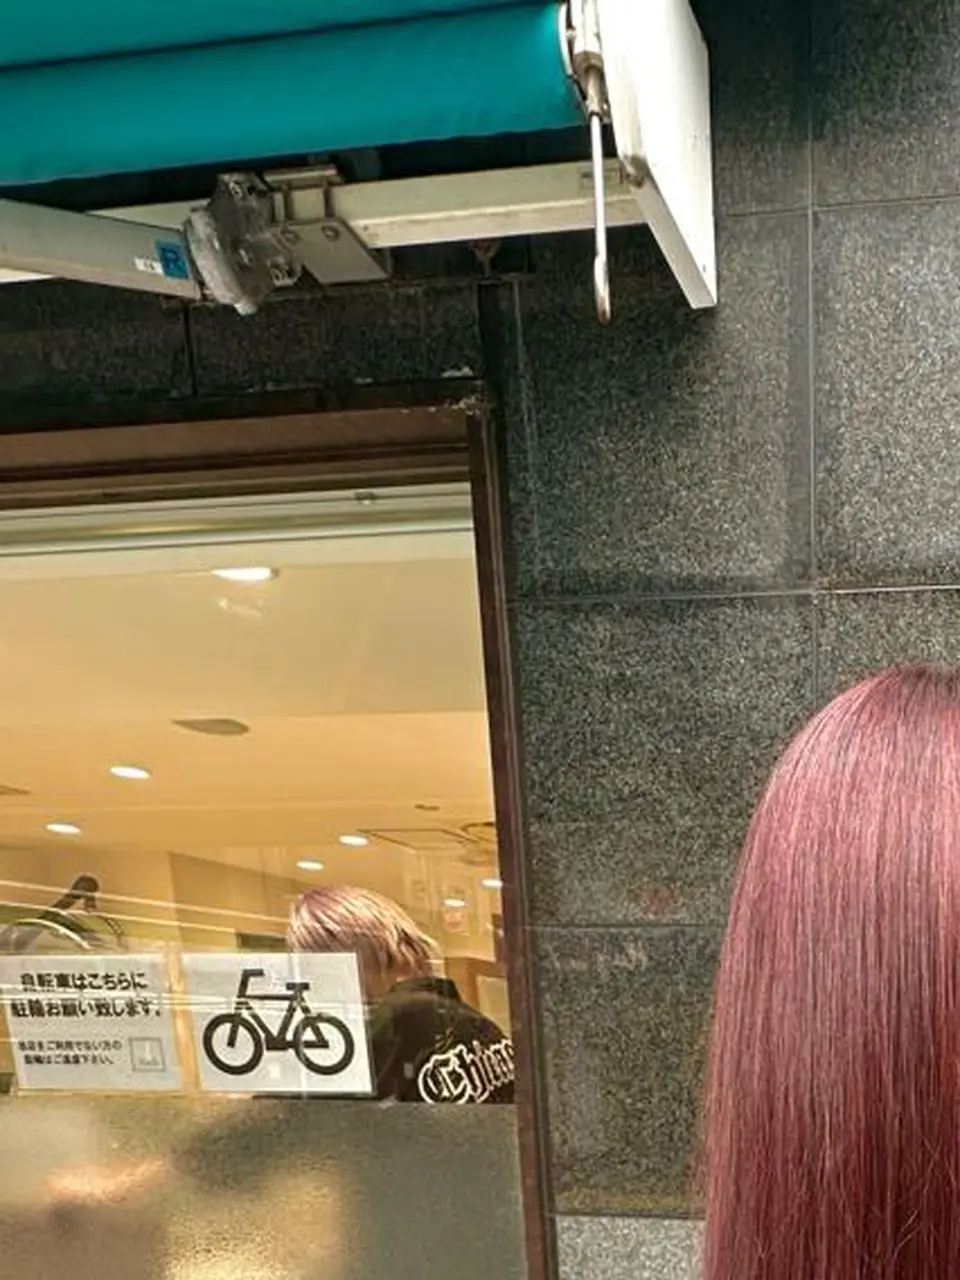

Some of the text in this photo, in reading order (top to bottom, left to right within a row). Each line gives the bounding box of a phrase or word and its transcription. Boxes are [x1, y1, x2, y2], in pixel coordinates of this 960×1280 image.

[20, 972, 148, 991] 自転車はこちらに
